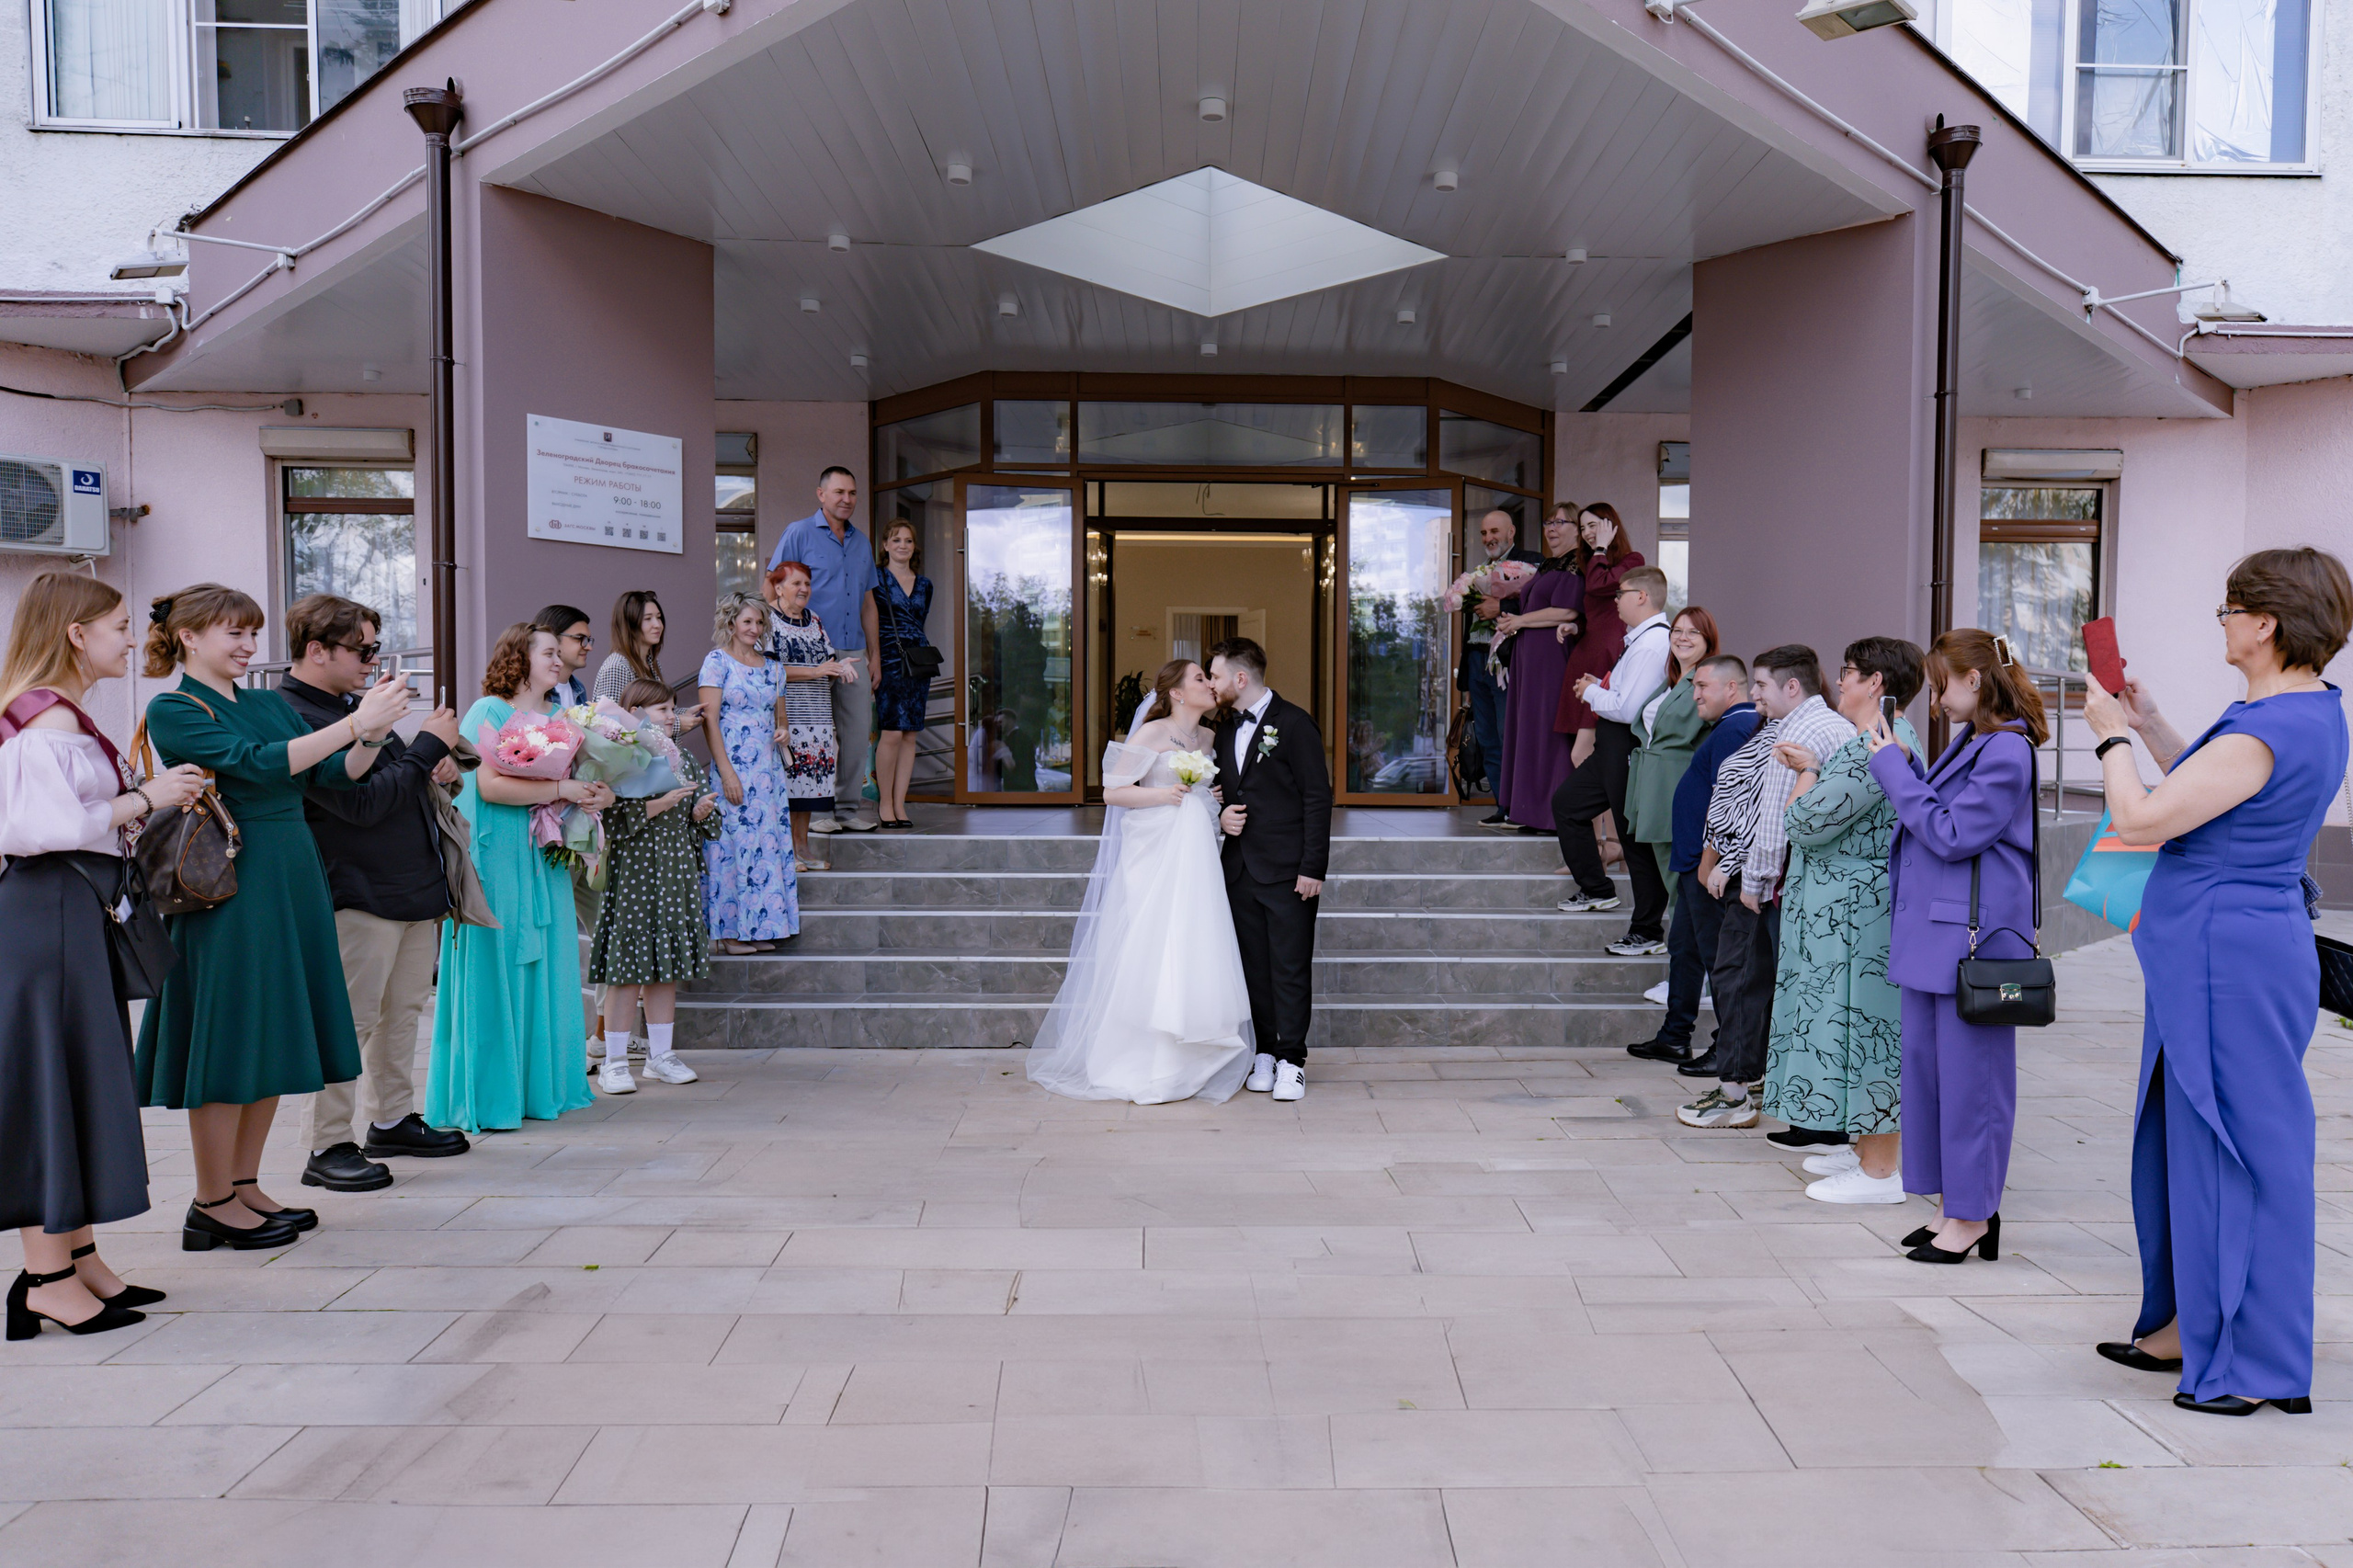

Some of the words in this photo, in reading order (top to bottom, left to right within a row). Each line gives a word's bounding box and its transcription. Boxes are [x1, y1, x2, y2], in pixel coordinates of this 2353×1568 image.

[537, 449, 594, 463] Зеленоградский
[595, 457, 621, 469] Дворец
[622, 461, 676, 475] бракосочетания
[574, 475, 607, 488] РЕЖИМ
[608, 481, 642, 493] РАБОТЫ
[613, 495, 632, 506] 9:00
[640, 499, 662, 510] 18:00
